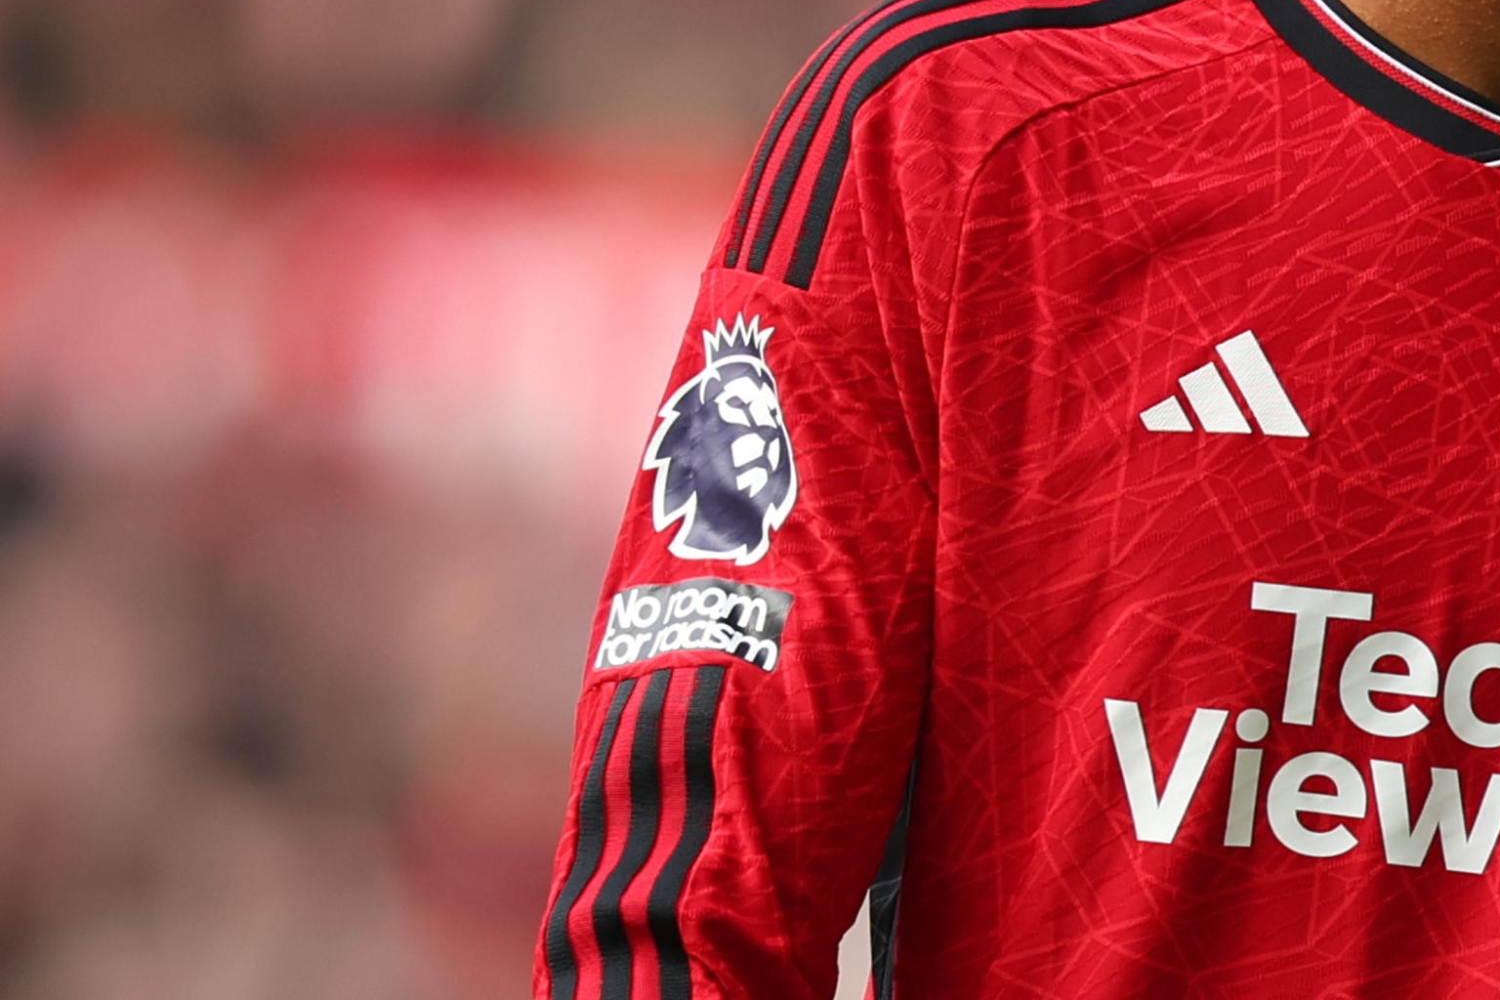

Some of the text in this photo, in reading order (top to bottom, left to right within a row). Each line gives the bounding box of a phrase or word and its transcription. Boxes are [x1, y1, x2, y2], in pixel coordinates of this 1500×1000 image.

[609, 587, 767, 632] No room
[594, 620, 778, 671] for racism
